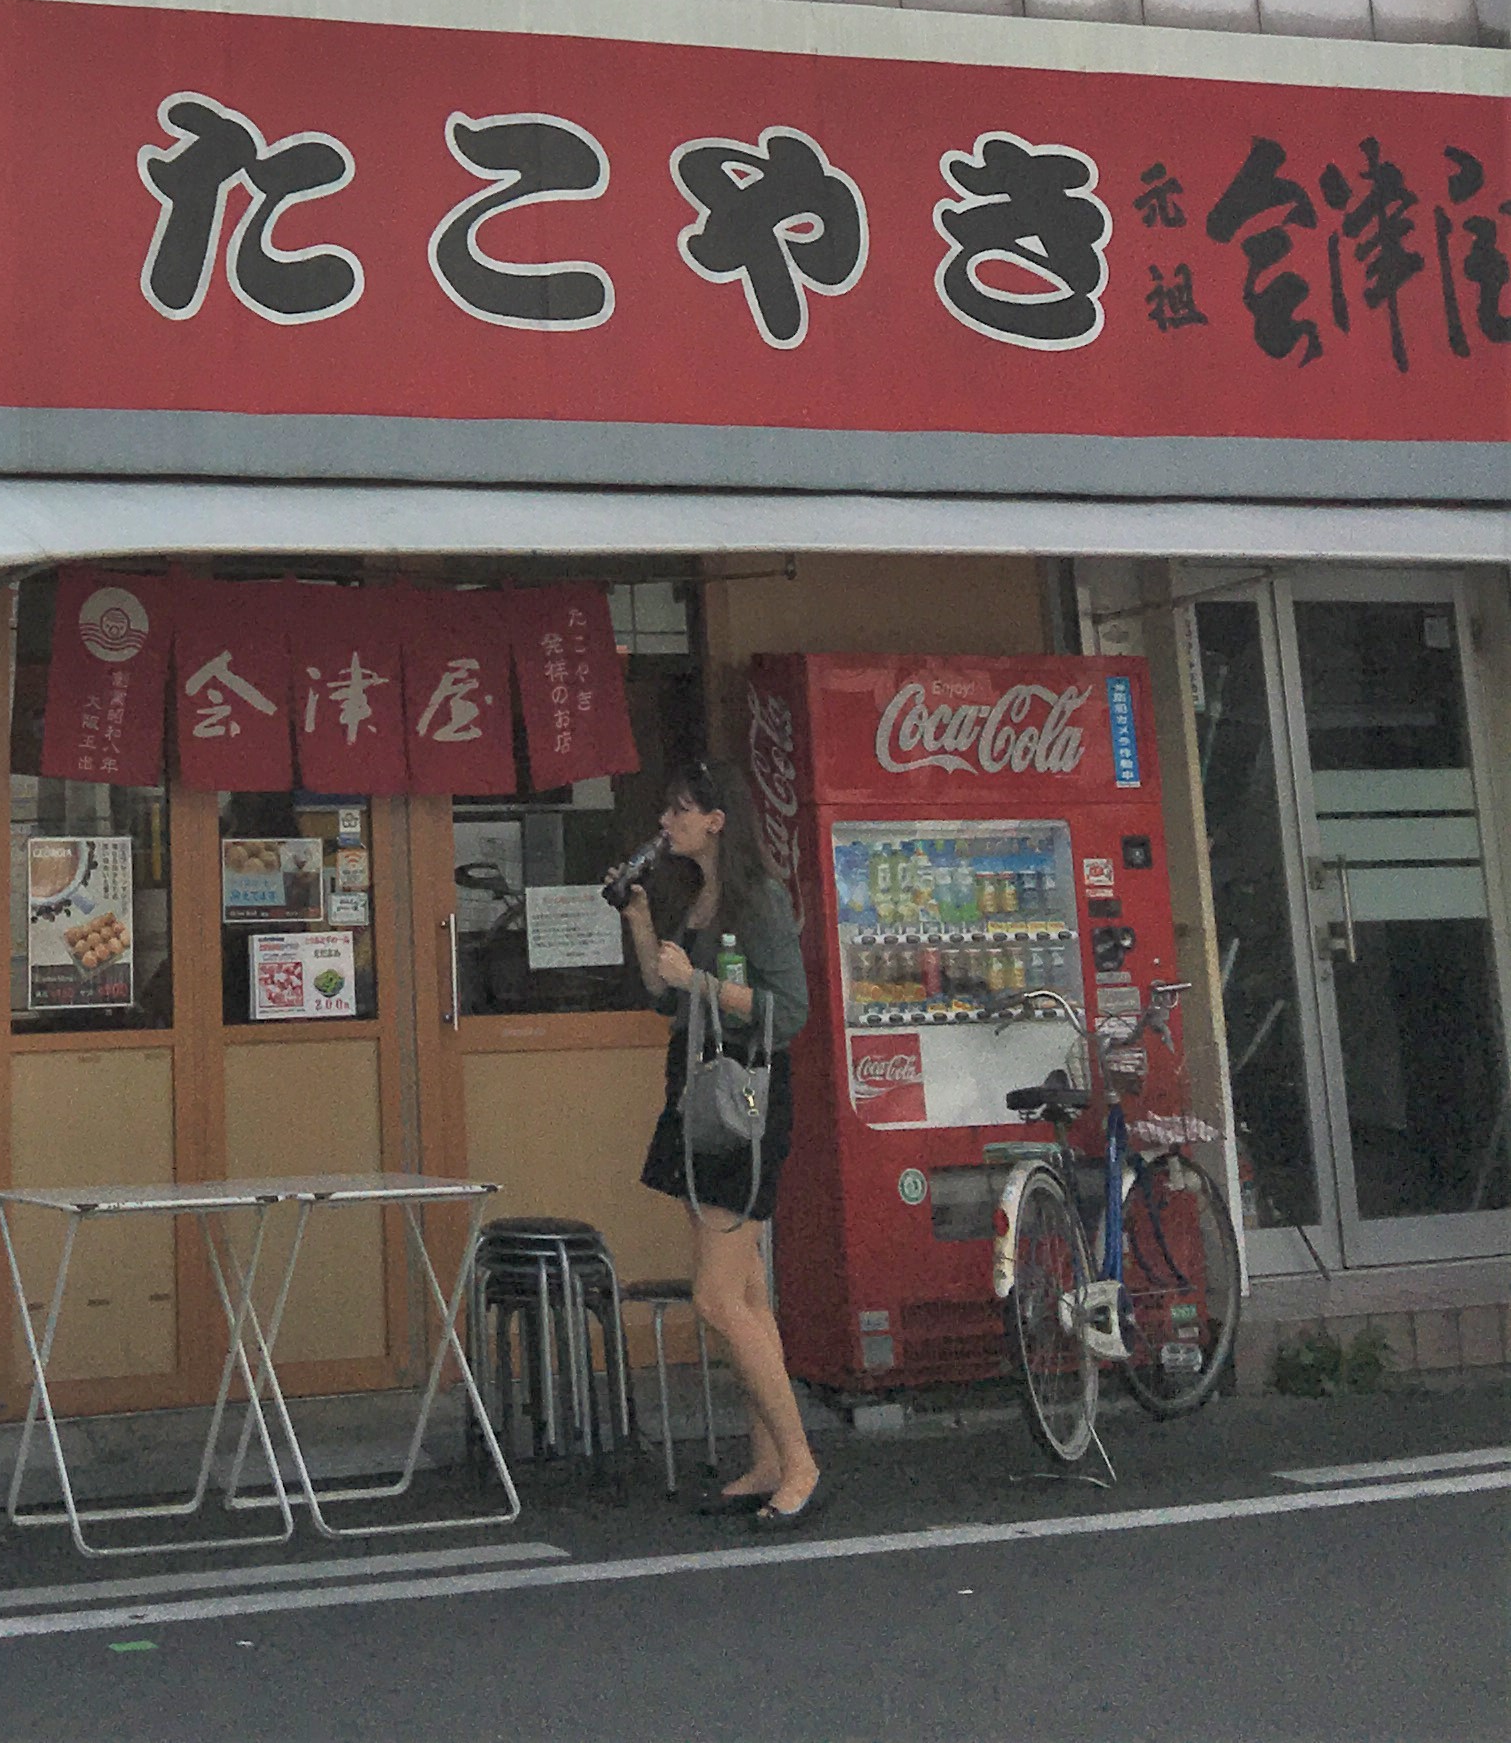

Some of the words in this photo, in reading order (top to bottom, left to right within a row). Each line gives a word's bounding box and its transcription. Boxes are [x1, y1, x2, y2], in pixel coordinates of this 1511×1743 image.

[137, 92, 1113, 352] たこやき
[1133, 162, 1209, 333] 元祖
[185, 649, 494, 746] 会津屋
[539, 632, 573, 755] 発祥のお店
[567, 608, 594, 711] たこやき
[875, 682, 1093, 776] Coca-Cola
